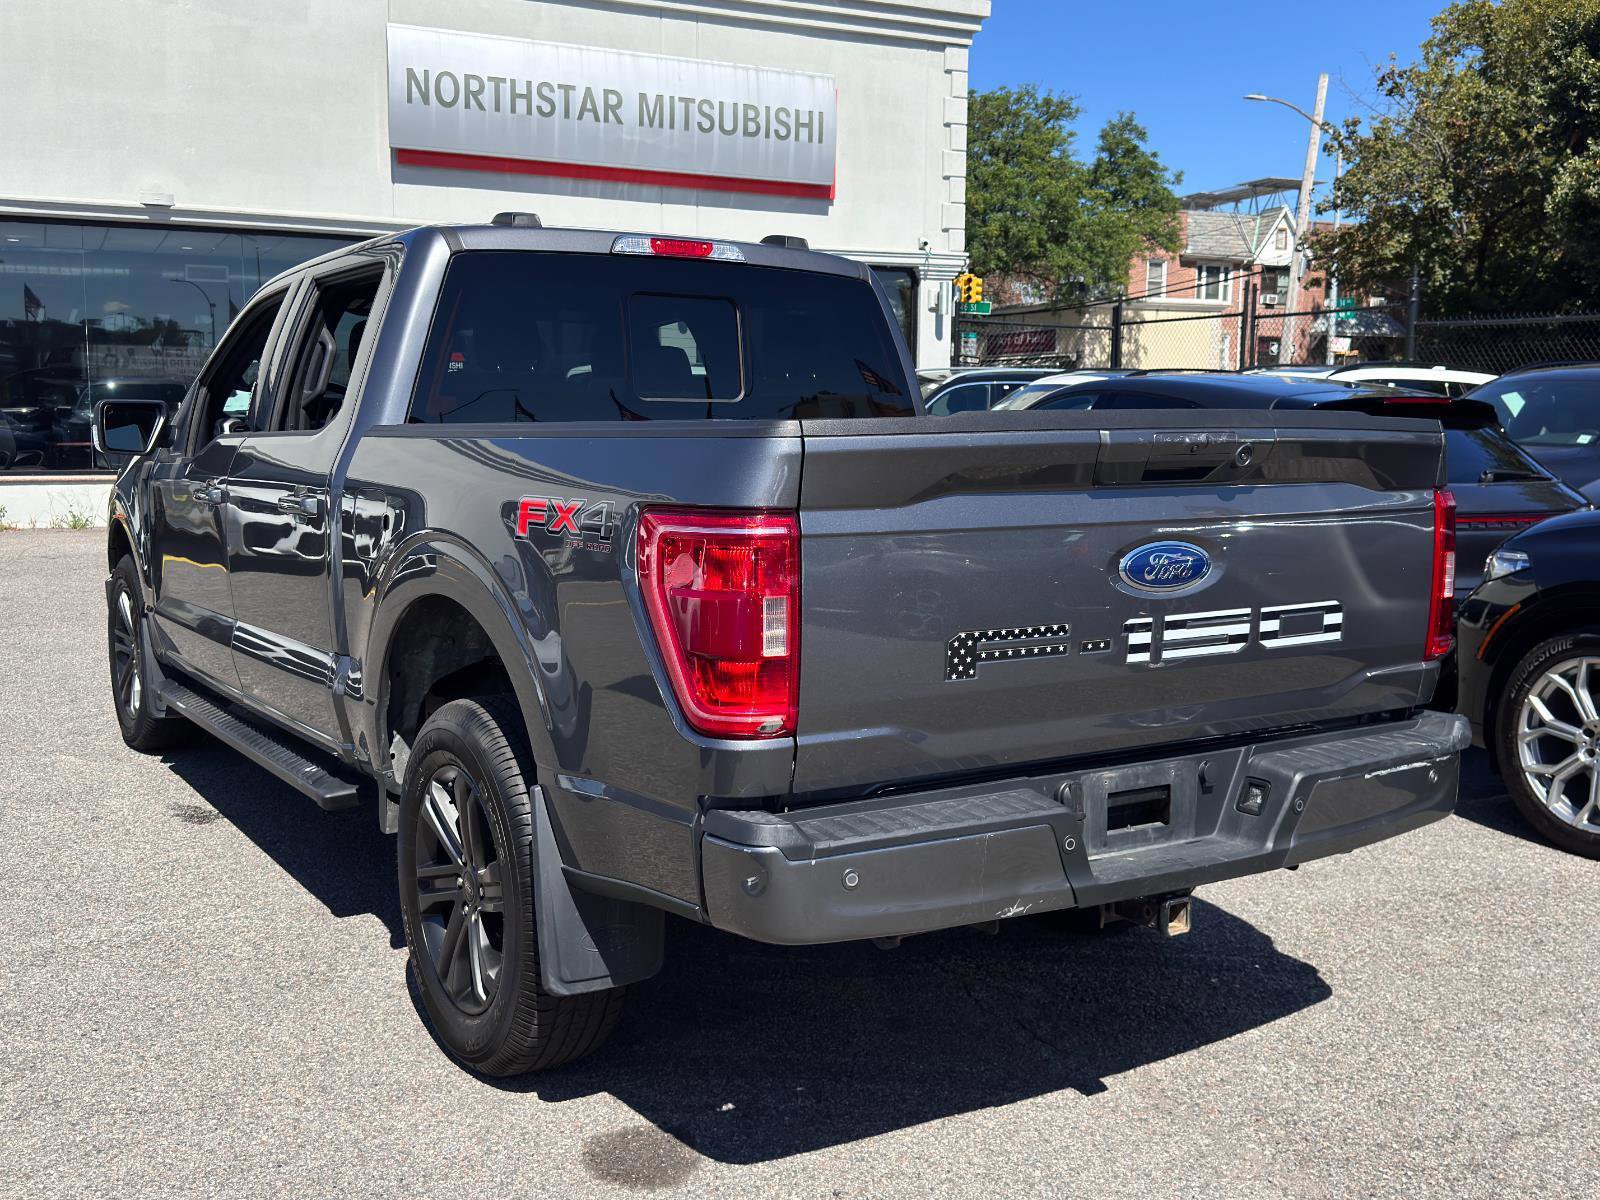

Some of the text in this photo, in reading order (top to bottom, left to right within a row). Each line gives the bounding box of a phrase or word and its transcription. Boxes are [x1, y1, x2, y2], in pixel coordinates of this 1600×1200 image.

[405, 67, 825, 144] NORTHSTAR MITSUBISHI
[514, 495, 616, 542] FX4
[566, 541, 612, 553] OFF ROAD
[1144, 552, 1194, 581] Ford
[944, 600, 1344, 682] F-150
